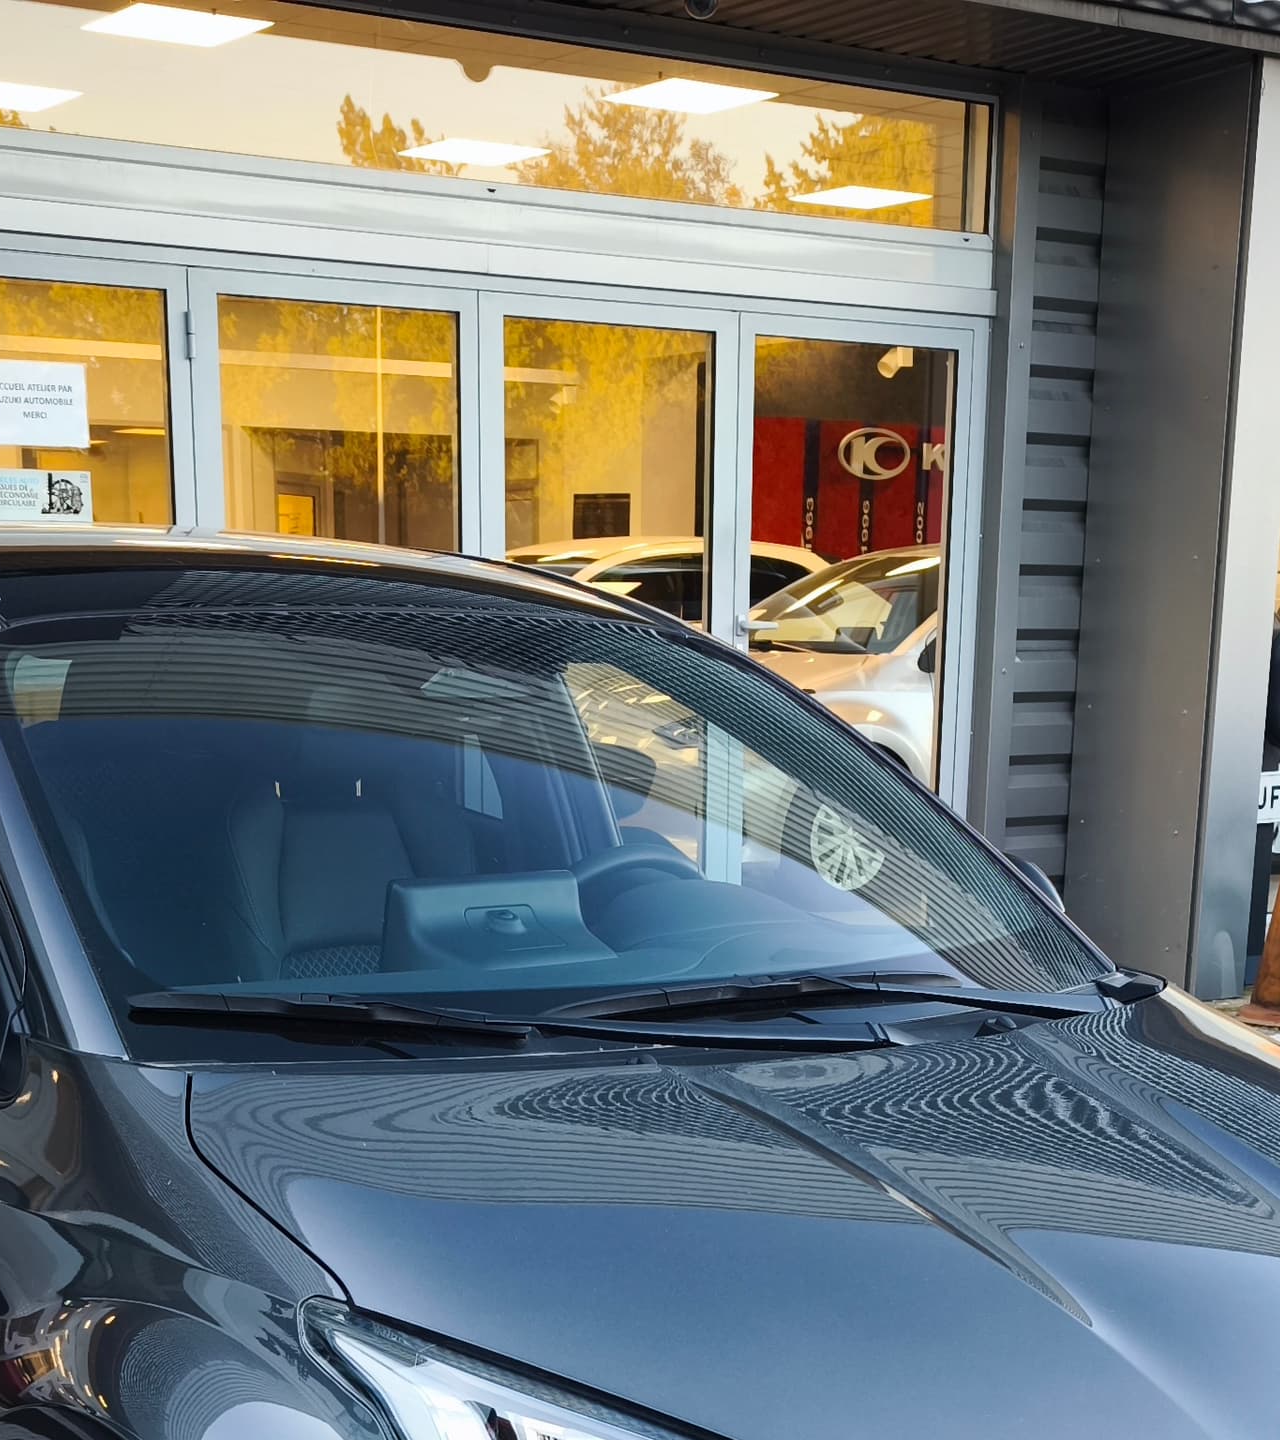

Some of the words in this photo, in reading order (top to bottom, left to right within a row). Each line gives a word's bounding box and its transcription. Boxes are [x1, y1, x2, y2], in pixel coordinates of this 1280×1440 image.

[27, 383, 57, 392] ATELIER
[58, 385, 73, 393] PAR
[23, 397, 73, 406] AUTOMOBILE
[23, 411, 47, 419] MERCI
